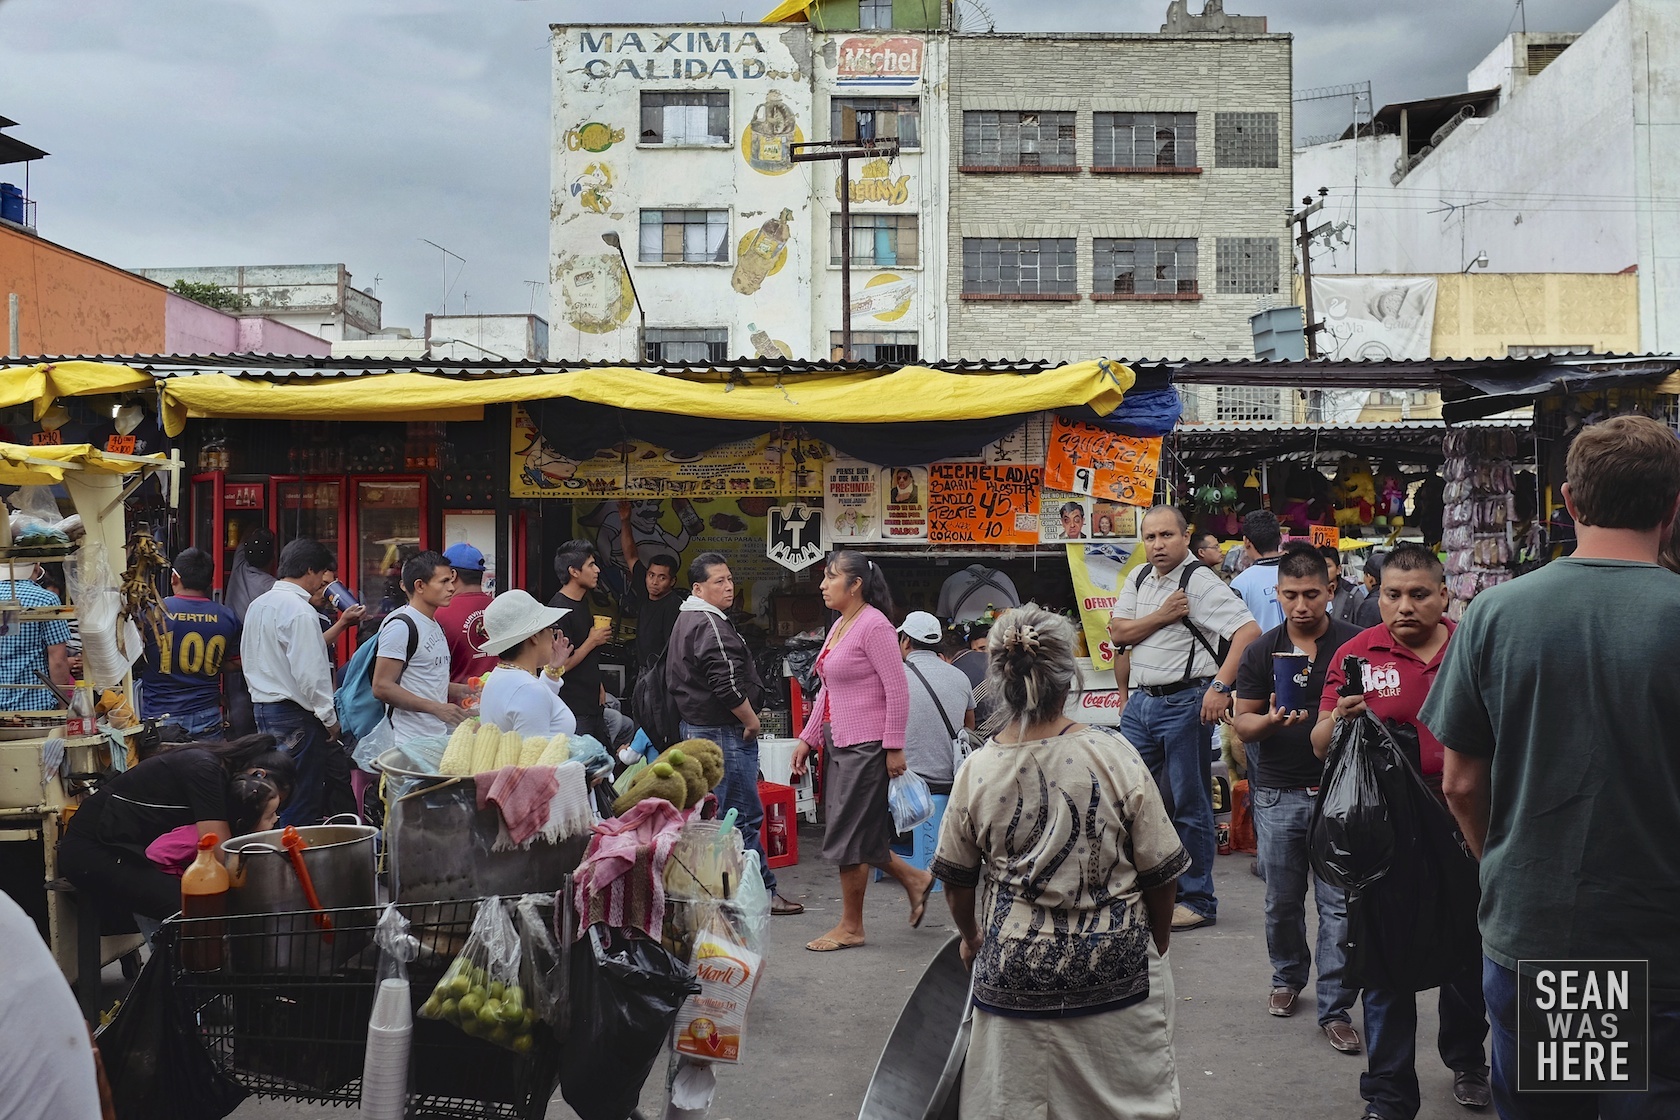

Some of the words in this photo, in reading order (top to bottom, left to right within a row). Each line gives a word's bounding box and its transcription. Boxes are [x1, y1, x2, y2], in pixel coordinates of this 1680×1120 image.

[580, 32, 766, 53] MAXIMA
[845, 43, 918, 73] Michel
[584, 58, 767, 80] CALIDAD
[830, 475, 838, 483] LO
[835, 467, 855, 475] PIENSE
[856, 467, 869, 475] BIEN
[930, 465, 1040, 486] MICHELADAS
[830, 482, 875, 493] PREGUNTAR
[1076, 468, 1090, 492] 9
[930, 492, 974, 505] INDIO
[979, 492, 1013, 519] 45
[928, 505, 977, 520] TECATE
[930, 519, 948, 531] XX
[978, 521, 1003, 538] 40
[784, 521, 806, 549] T
[930, 531, 976, 542] CORONA
[169, 612, 218, 623] VERTIN
[158, 631, 227, 677] 100
[1098, 641, 1114, 661] $
[1377, 688, 1402, 698] SURF
[697, 962, 737, 985] Marli
[724, 1047, 737, 1056] 250
